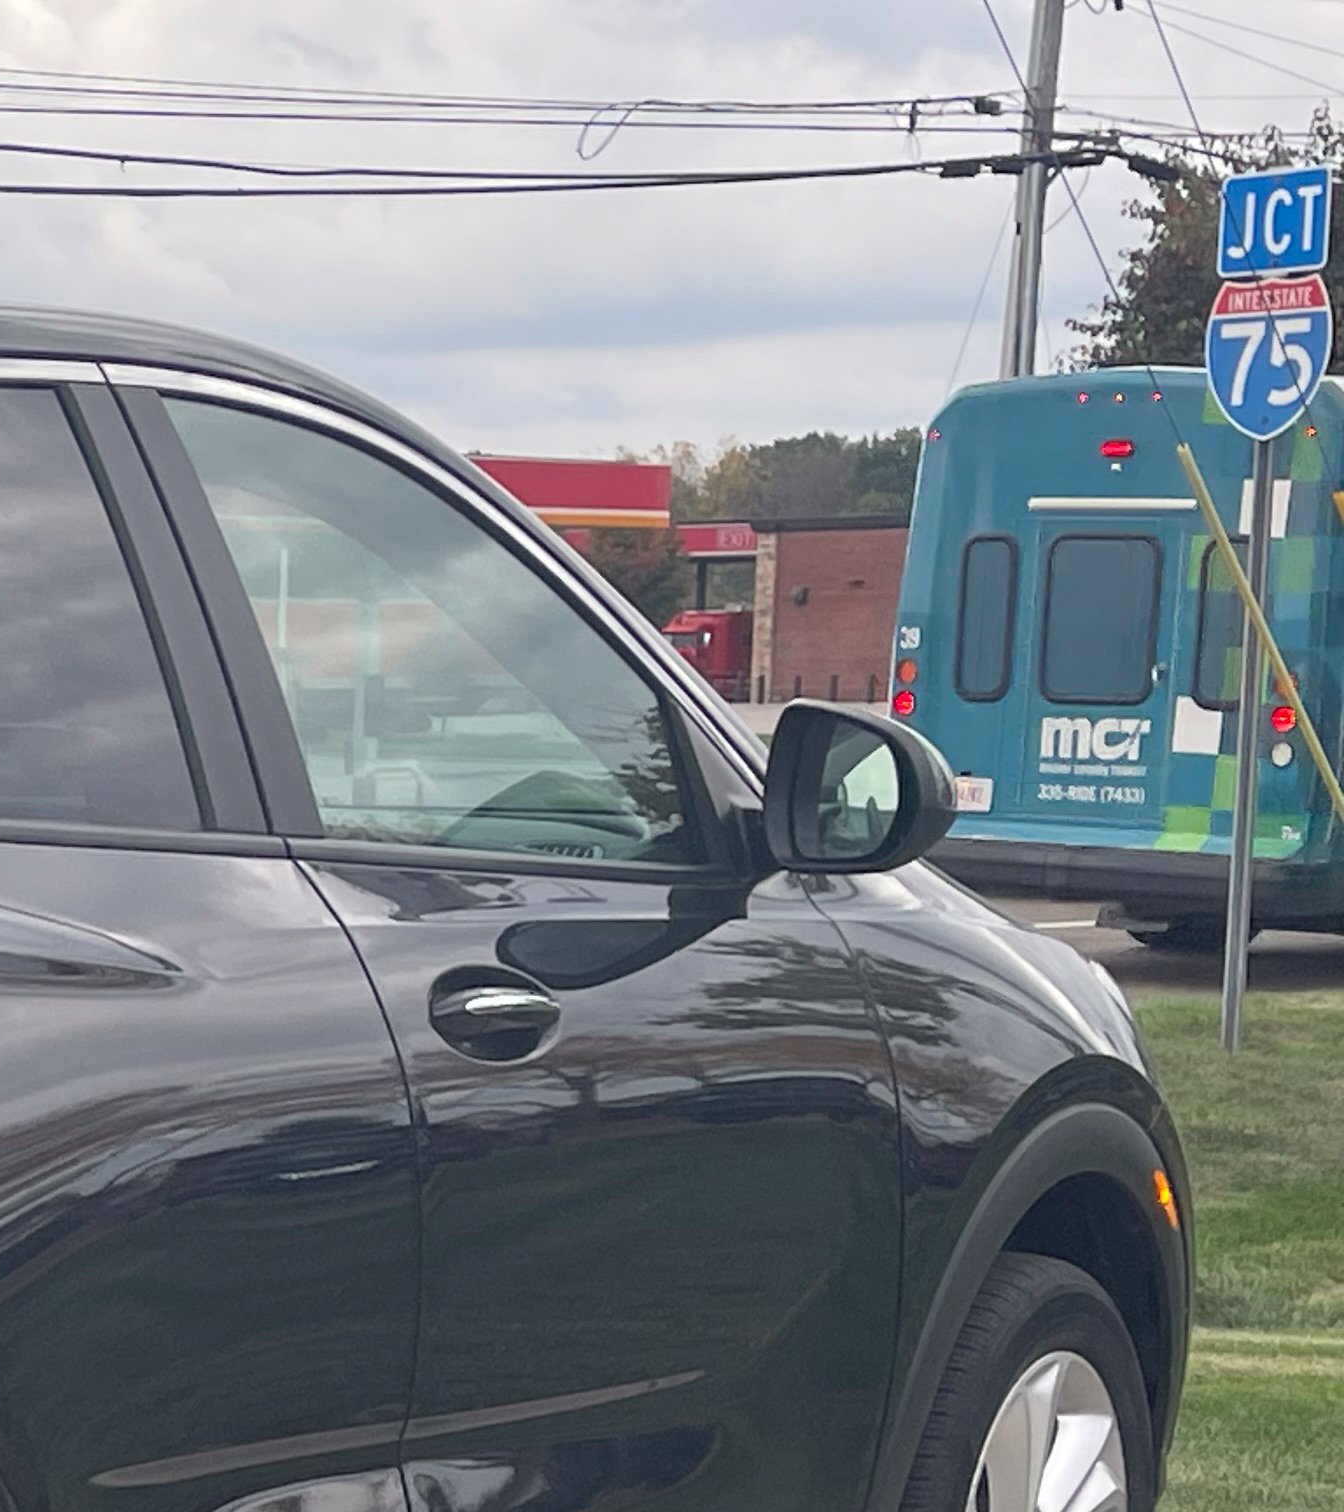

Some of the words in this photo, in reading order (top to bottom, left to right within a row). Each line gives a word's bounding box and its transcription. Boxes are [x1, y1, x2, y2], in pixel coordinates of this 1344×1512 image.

[1226, 184, 1323, 259] JCT
[1227, 286, 1313, 313] INTERSTATE
[1219, 317, 1313, 407] 75
[899, 625, 921, 650] 39
